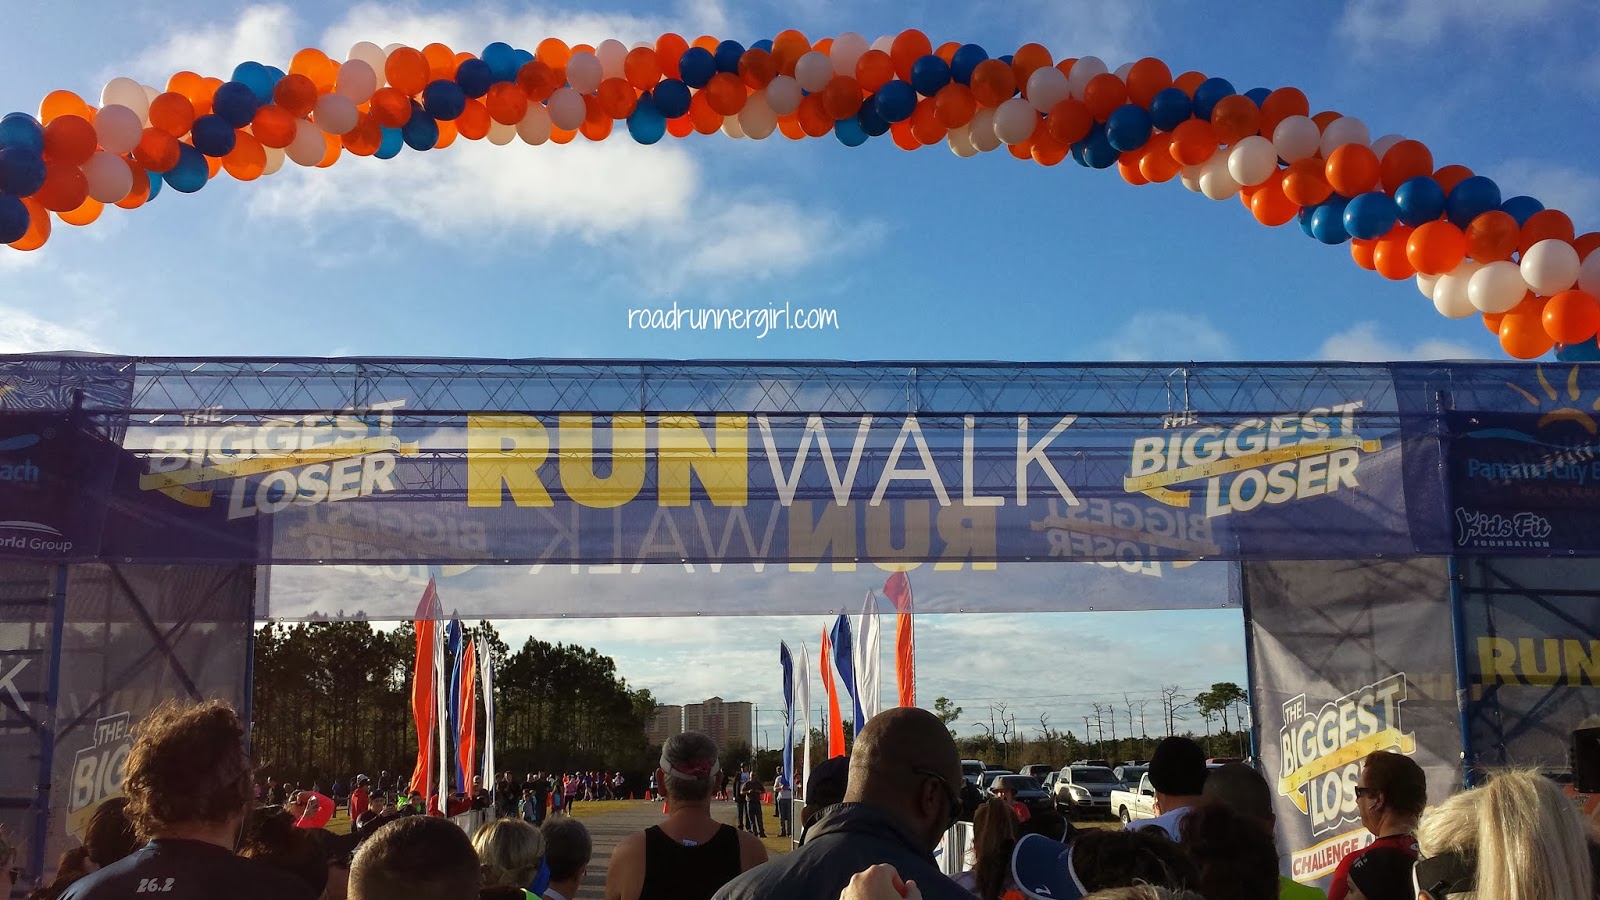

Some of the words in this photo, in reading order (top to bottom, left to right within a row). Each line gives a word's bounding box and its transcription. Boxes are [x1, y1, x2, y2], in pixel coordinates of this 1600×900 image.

[184, 405, 224, 426] THE
[1163, 410, 1199, 429] THE
[152, 400, 405, 473] BIGGEST
[1131, 400, 1363, 478] BIGGEST
[227, 453, 396, 520] LOSER
[1206, 450, 1360, 518] LOSER
[29, 537, 73, 552] Group
[1455, 507, 1512, 546] Kids
[1513, 512, 1551, 538] Fit
[1474, 539, 1550, 548] FOUNDATION
[1477, 637, 1600, 687] RUN
[1282, 683, 1400, 777] BIGGEST
[1284, 701, 1303, 723] THE
[98, 720, 124, 746] THE
[1293, 838, 1359, 876] CHALLENGE
[136, 877, 176, 893] 26.2
